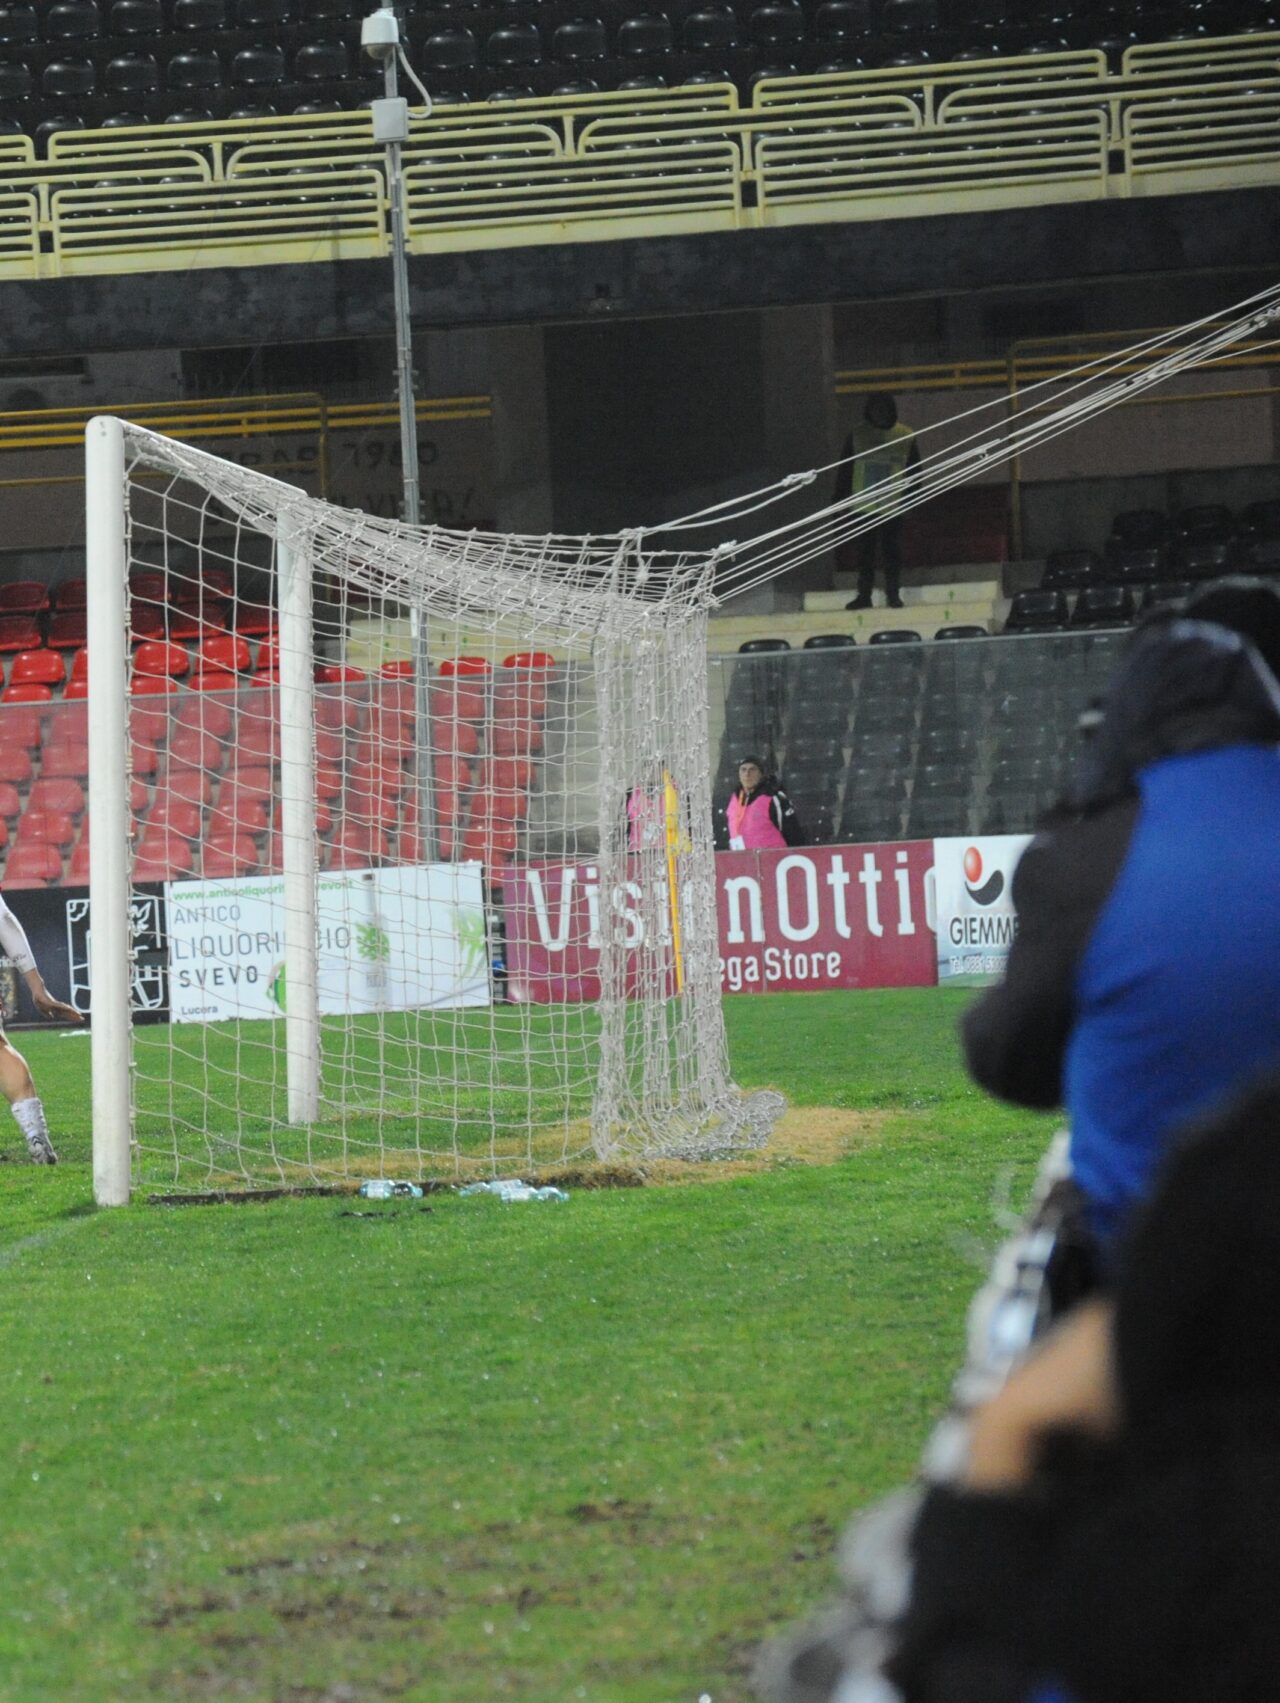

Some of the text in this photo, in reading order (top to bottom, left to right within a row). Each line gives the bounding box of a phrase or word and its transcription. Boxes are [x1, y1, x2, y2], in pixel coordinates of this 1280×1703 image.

[174, 904, 241, 925] ANTICO
[179, 965, 258, 988] SVEVO
[181, 1004, 219, 1016] Lucera
